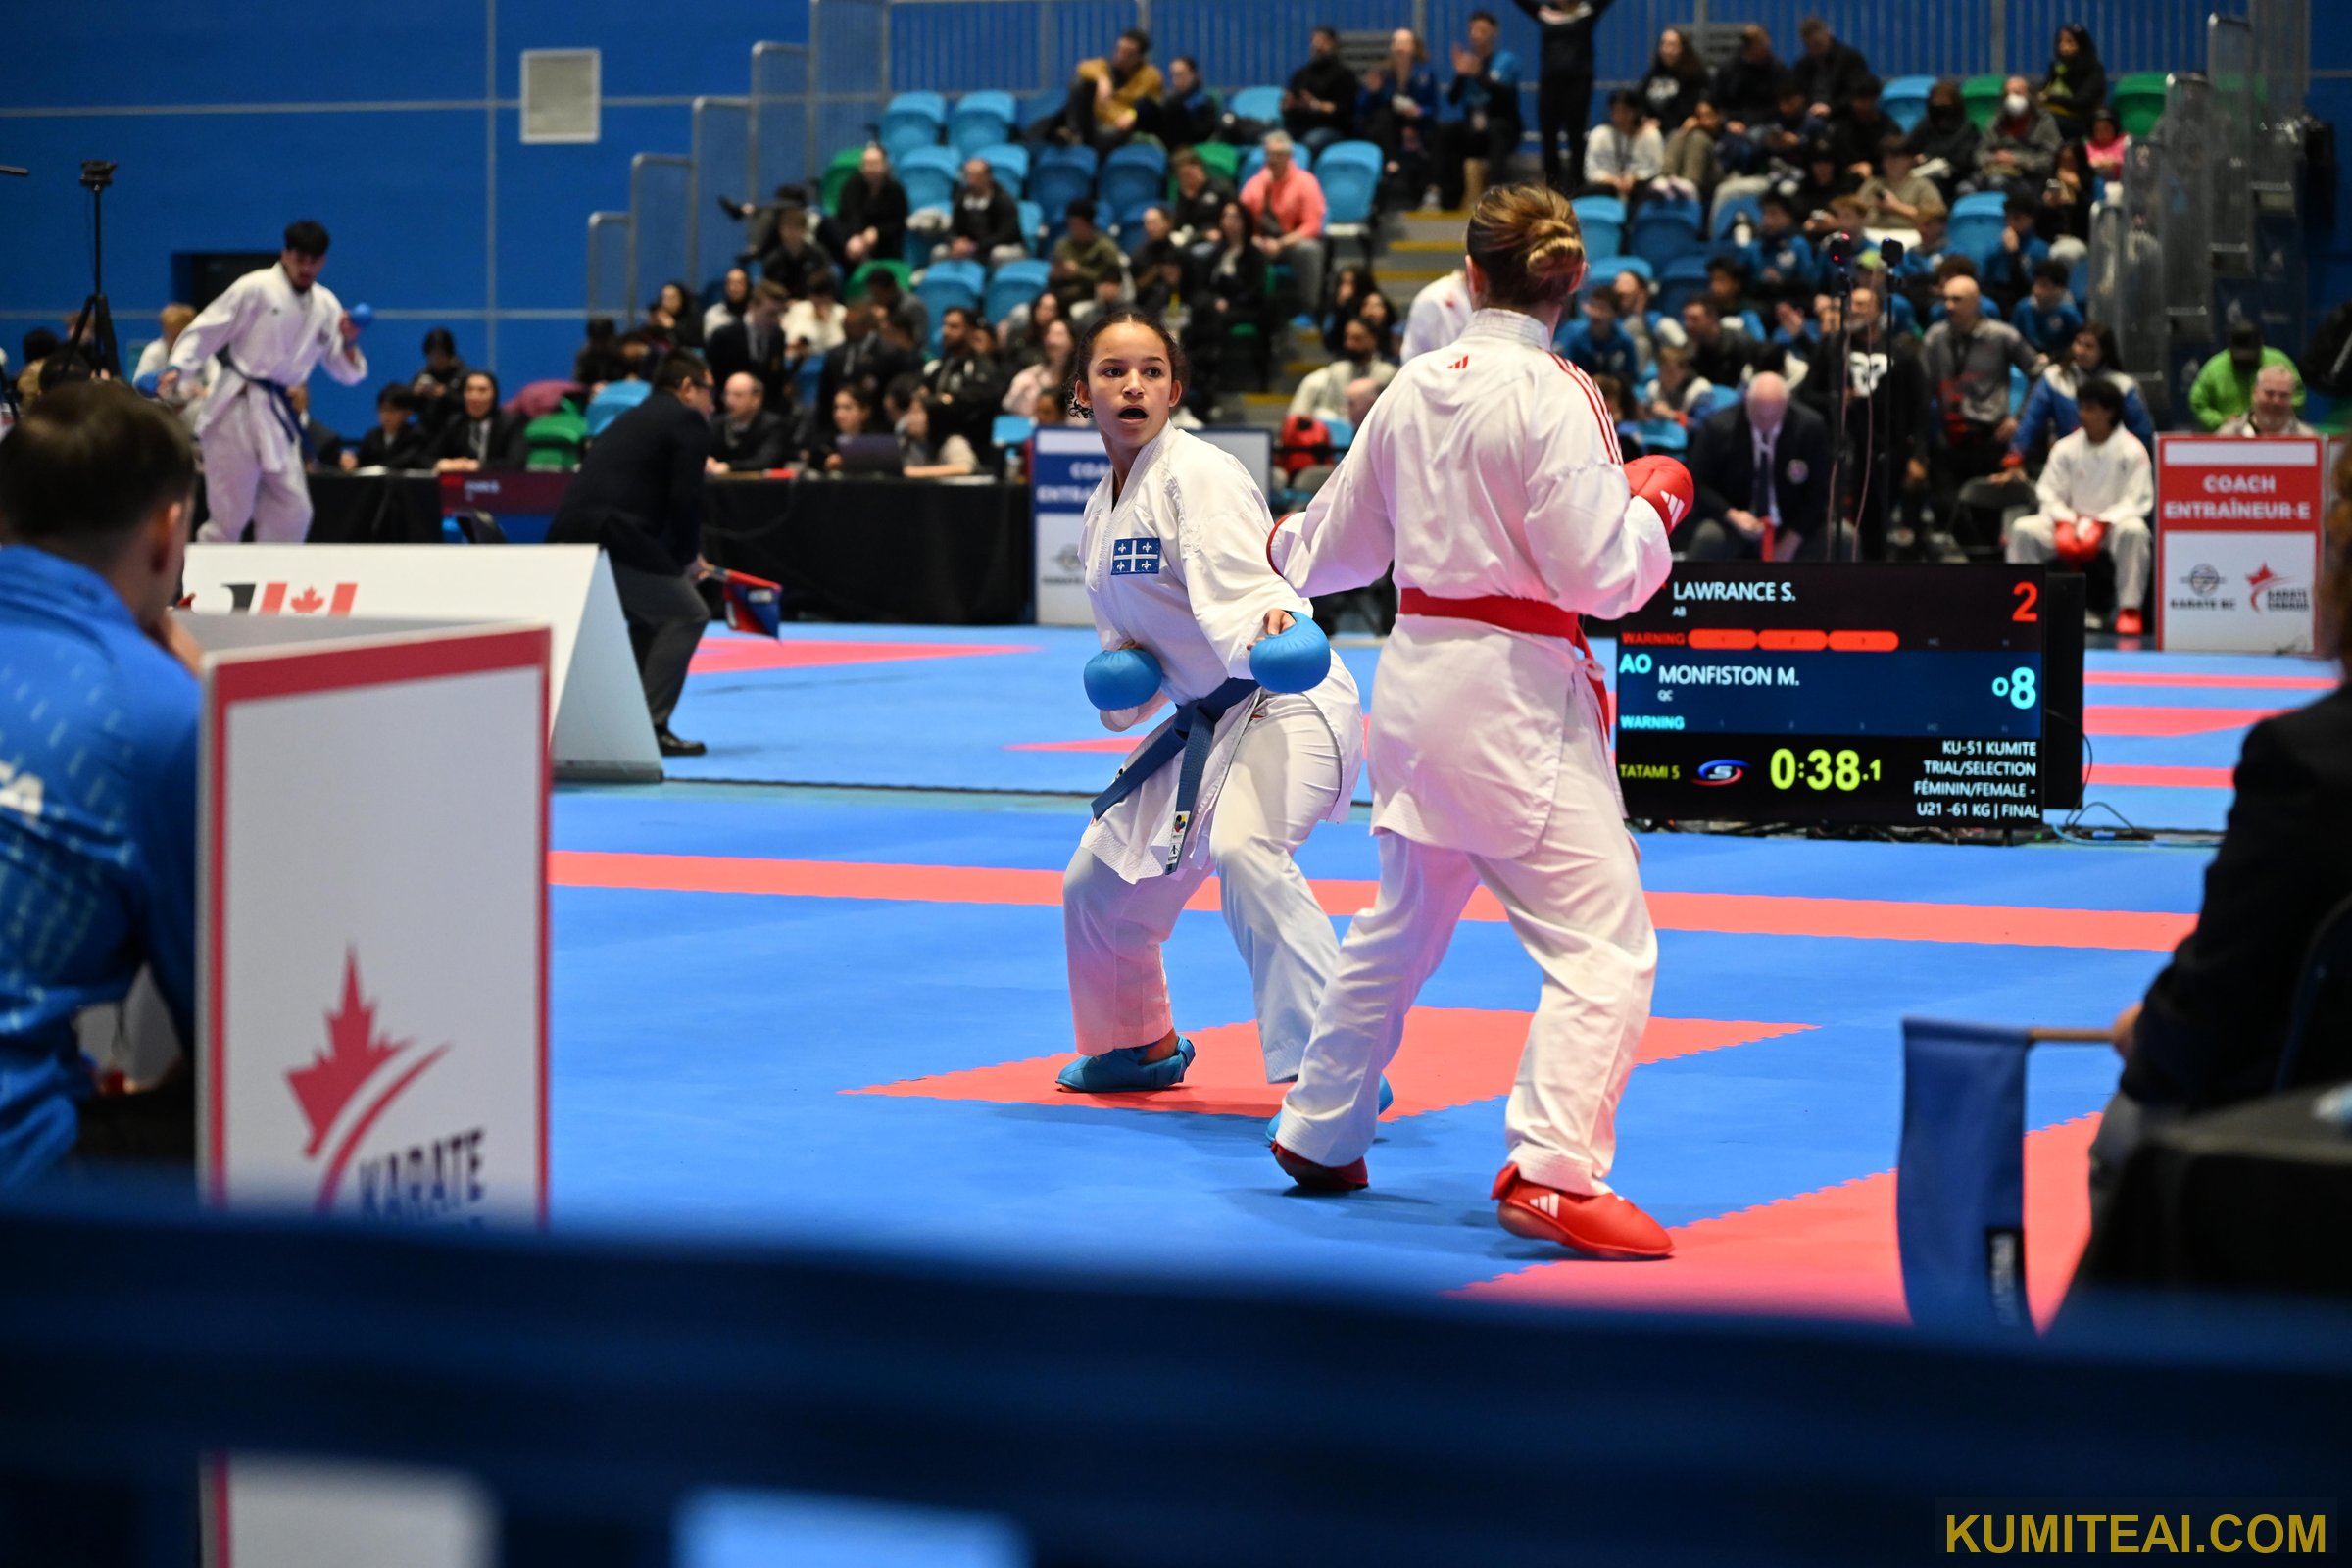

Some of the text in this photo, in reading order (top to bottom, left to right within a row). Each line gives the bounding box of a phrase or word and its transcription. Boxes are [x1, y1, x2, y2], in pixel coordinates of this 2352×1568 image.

[2203, 475, 2276, 493] COACH
[1673, 581, 1796, 602] LAWRANCE S.
[2012, 581, 2038, 622] 2
[1672, 606, 1687, 617] AB
[1622, 632, 1685, 646] WARNING
[1619, 653, 1652, 674] AO
[1658, 665, 1800, 686] MONFISTON M.
[1620, 715, 1685, 730] WARNING
[1942, 740, 2037, 757] KU-51 KUMITE
[1620, 764, 1668, 778] TATAMI
[1923, 760, 2036, 777] TRIAL/SELECTION
[1913, 777, 2027, 797] FÉMININ/FEMALE
[1916, 802, 1942, 816] U21
[1946, 803, 1968, 817] -61
[1972, 803, 1991, 817] KG
[2001, 804, 2039, 818] FINAL
